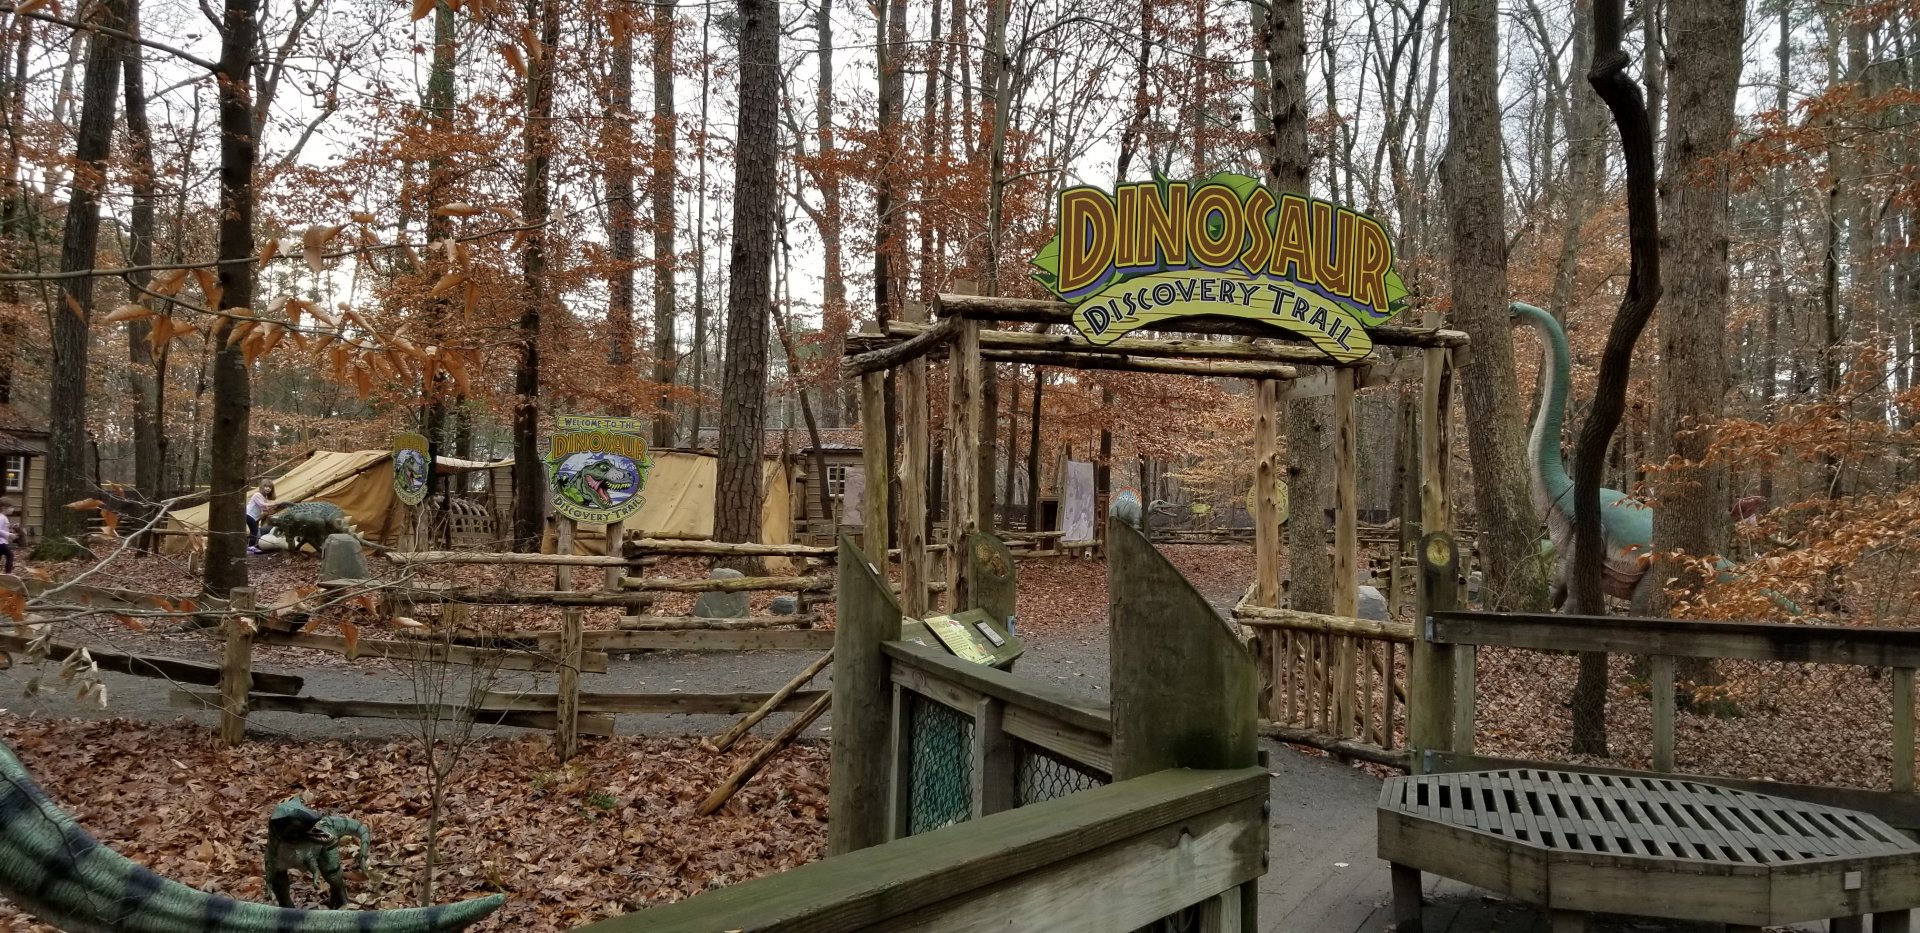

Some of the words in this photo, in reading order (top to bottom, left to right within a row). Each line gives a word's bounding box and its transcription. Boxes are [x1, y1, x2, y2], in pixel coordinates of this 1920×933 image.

[1058, 183, 1392, 313] DINOSAUR
[1082, 278, 1260, 337] DISCOVERY
[1267, 284, 1356, 352] TRAIL
[564, 418, 601, 426] WELCOME
[605, 419, 617, 428] TO
[620, 420, 635, 429] THE
[553, 432, 646, 462] DINOSAUR
[553, 497, 611, 521] DISCOVERY
[612, 498, 643, 519] TRAIL
